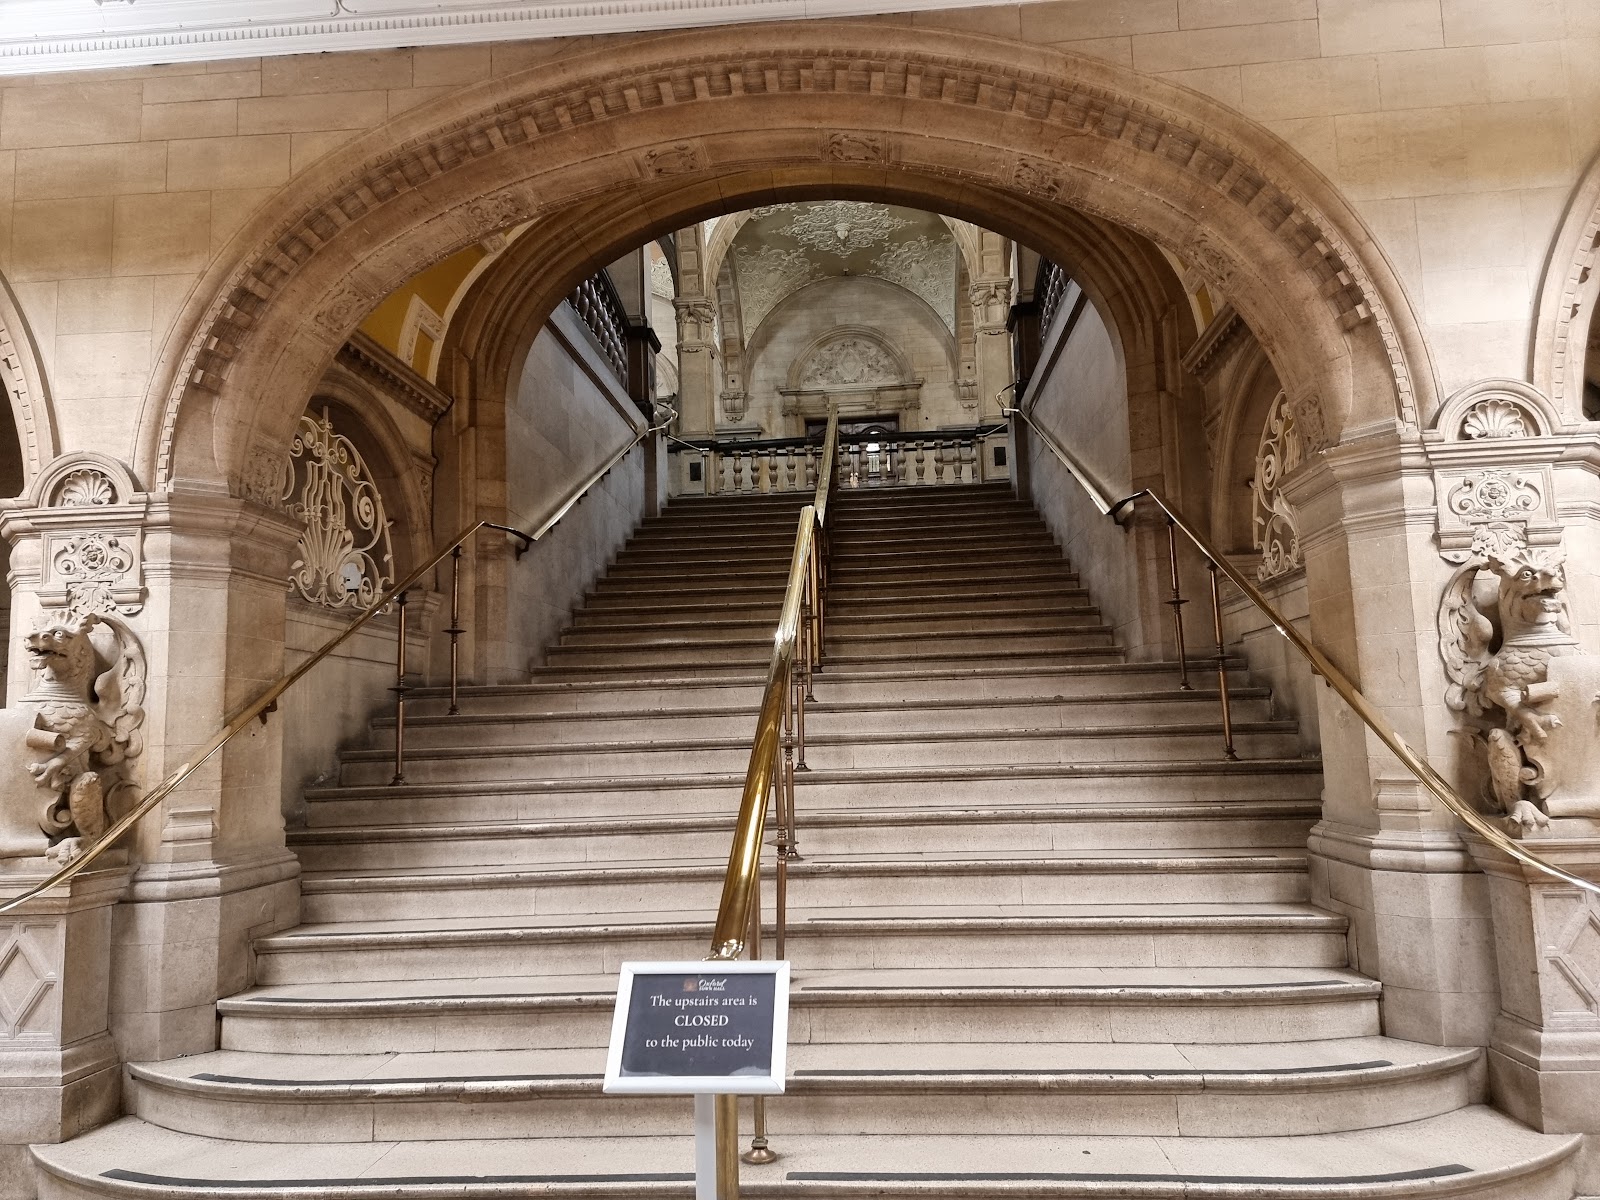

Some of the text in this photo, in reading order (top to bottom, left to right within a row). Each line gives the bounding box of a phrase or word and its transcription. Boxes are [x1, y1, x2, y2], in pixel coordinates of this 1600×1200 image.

[698, 978, 727, 987] Oxford
[650, 994, 757, 1009] The upstairs area is
[674, 1015, 729, 1026] CLOSED
[645, 1034, 754, 1051] to the public today
